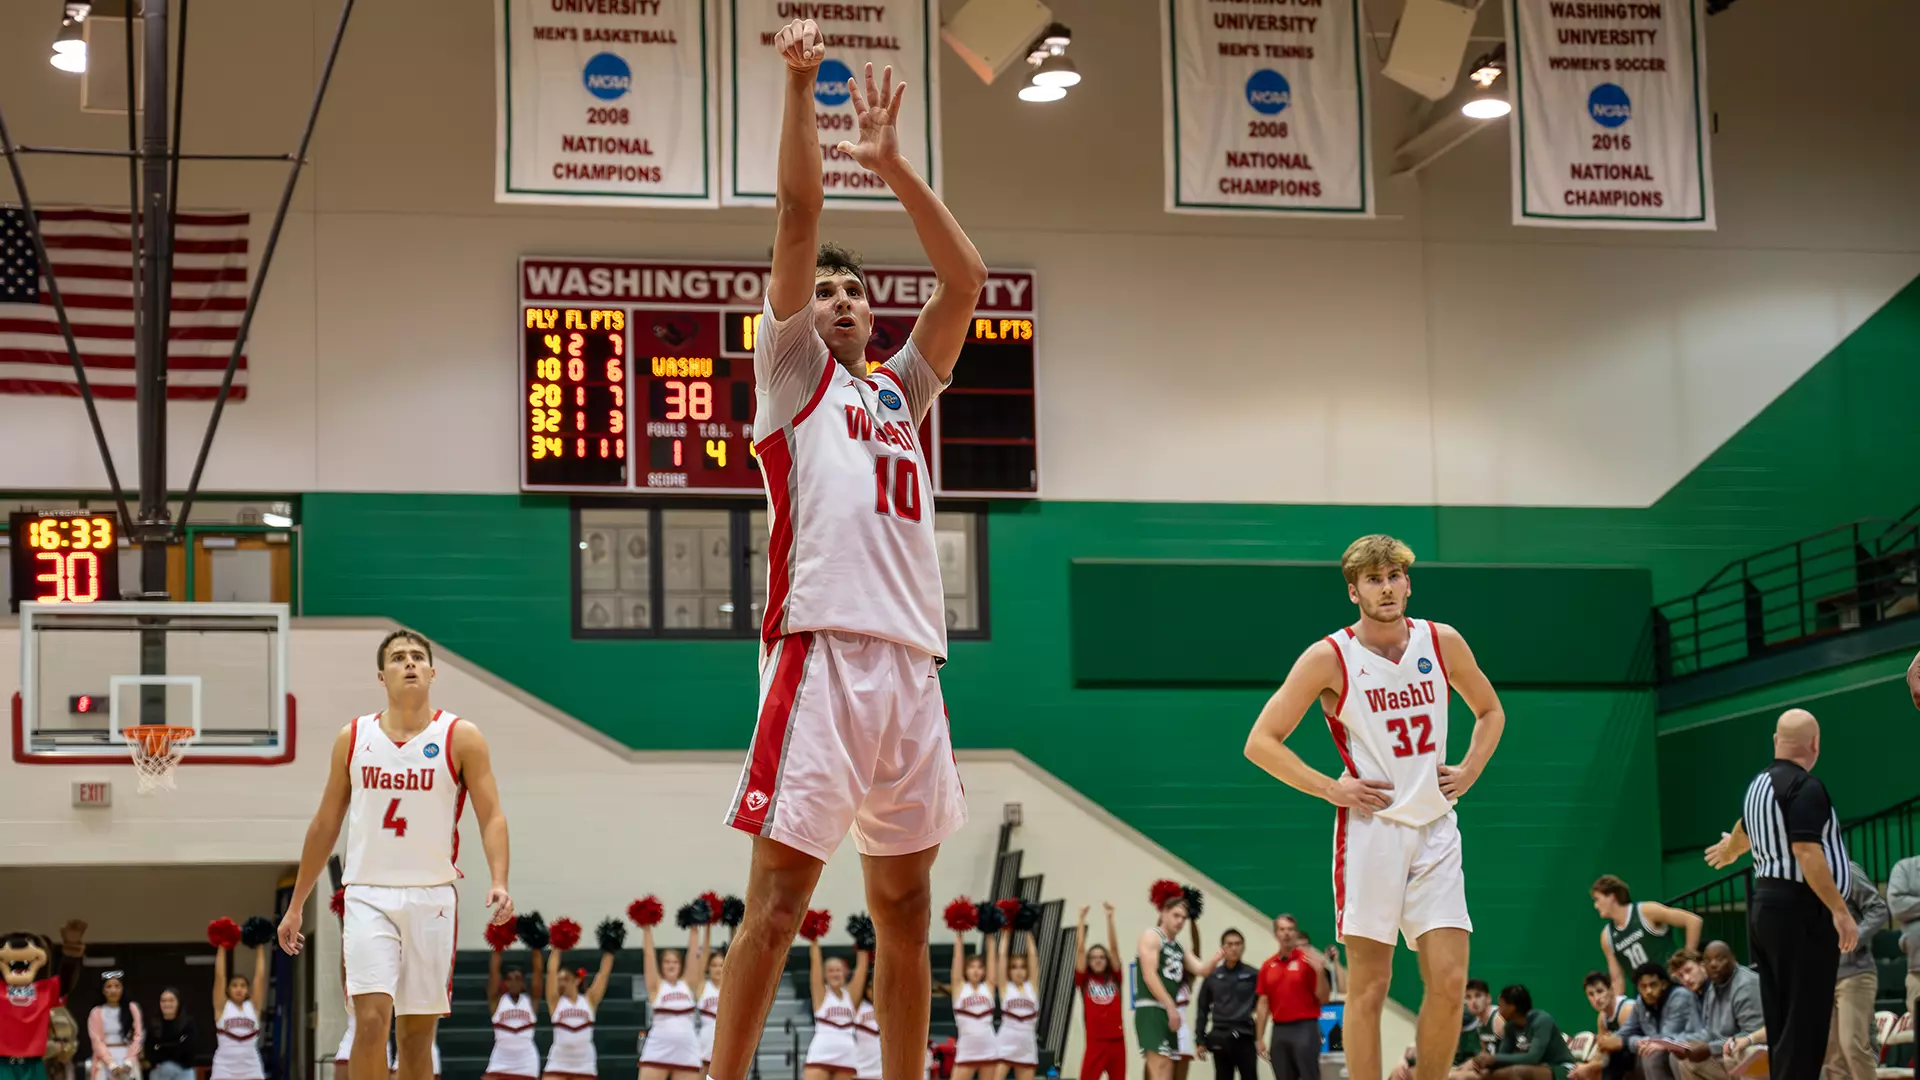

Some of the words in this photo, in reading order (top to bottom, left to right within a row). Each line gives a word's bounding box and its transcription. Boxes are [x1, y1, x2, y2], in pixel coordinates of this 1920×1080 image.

[552, 0, 661, 15] UNIVERSITY
[778, 3, 885, 22] UNIVERSITY
[1550, 3, 1661, 19] WASHINGTON
[1214, 13, 1317, 33] UNIVERSITY
[533, 26, 578, 42] MEN'S
[583, 28, 677, 44] BASKETBALL
[824, 33, 901, 50] ASKETBALL
[1557, 29, 1658, 45] UNIVERSITY
[1218, 42, 1260, 57] MEN'S
[1264, 44, 1314, 60] TENNIS
[1549, 56, 1611, 71] WOMEN'S
[1615, 57, 1667, 72] SOCCER
[587, 74, 629, 90] NCAA
[587, 107, 629, 125] 2008
[1248, 121, 1288, 138] 2008
[562, 135, 653, 155] NATIONAL
[1592, 134, 1631, 150] 2016
[1226, 152, 1313, 170] NATIONAL
[553, 163, 662, 183] CHAMPIONS
[822, 172, 885, 188] MPIONS
[1570, 163, 1654, 181] NATIONAL
[1219, 178, 1322, 197] CHAMPIONS
[1564, 190, 1663, 208] CHAMPIONS
[527, 267, 771, 298] WASHINGTO
[565, 309, 588, 330] FL
[590, 310, 625, 331] PTS
[975, 319, 998, 339] FL
[1000, 319, 1032, 340] PTS
[544, 334, 561, 355] 4
[568, 333, 585, 356] 2
[609, 333, 623, 355] 7
[537, 357, 562, 381] 10
[568, 358, 585, 381] 0
[607, 358, 623, 382] 6
[652, 357, 713, 378] WASHU
[529, 383, 562, 408] 20
[576, 386, 585, 407] 1
[609, 385, 623, 407] 7
[665, 381, 713, 421] 38
[531, 408, 562, 432] 32
[576, 411, 585, 431] 1
[609, 410, 623, 434] 3
[647, 422, 687, 437] FOULS
[531, 434, 563, 459] 34
[576, 437, 585, 458] 1
[600, 437, 624, 459] 11
[673, 439, 683, 467] 1
[706, 439, 727, 468] 4
[647, 473, 687, 487] SCORE
[873, 454, 921, 523] 10
[29, 518, 112, 550] 16:33
[37, 551, 98, 604] 30
[1365, 680, 1436, 713] WashU
[1386, 714, 1436, 758] 32
[361, 766, 435, 791] WashU
[79, 784, 107, 802] EXIT
[382, 798, 408, 837] 4
